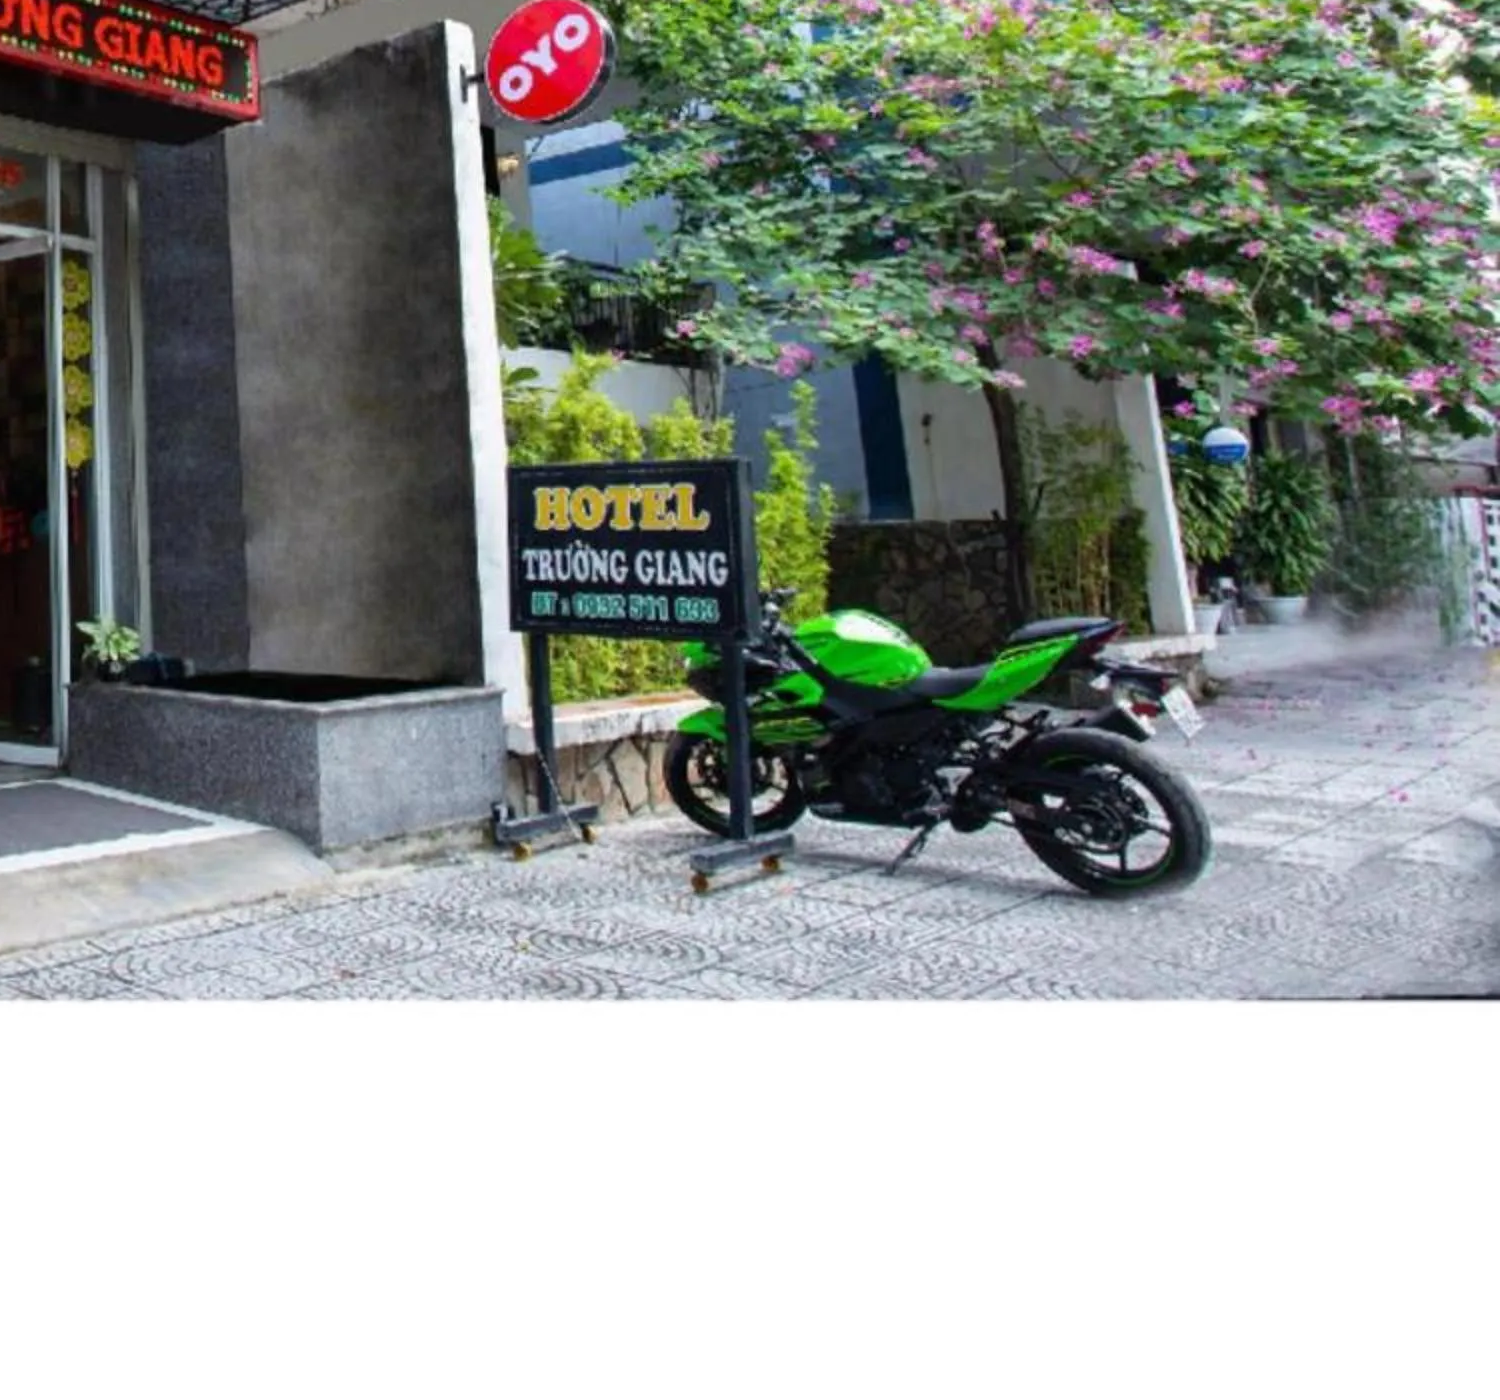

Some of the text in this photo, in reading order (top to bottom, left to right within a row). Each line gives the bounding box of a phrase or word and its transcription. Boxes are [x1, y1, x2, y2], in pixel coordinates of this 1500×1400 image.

[94, 16, 224, 86] GIANG
[499, 13, 590, 103] OYO
[533, 483, 711, 531] HOTEL
[521, 540, 729, 586] TRƯỜNG GIANG
